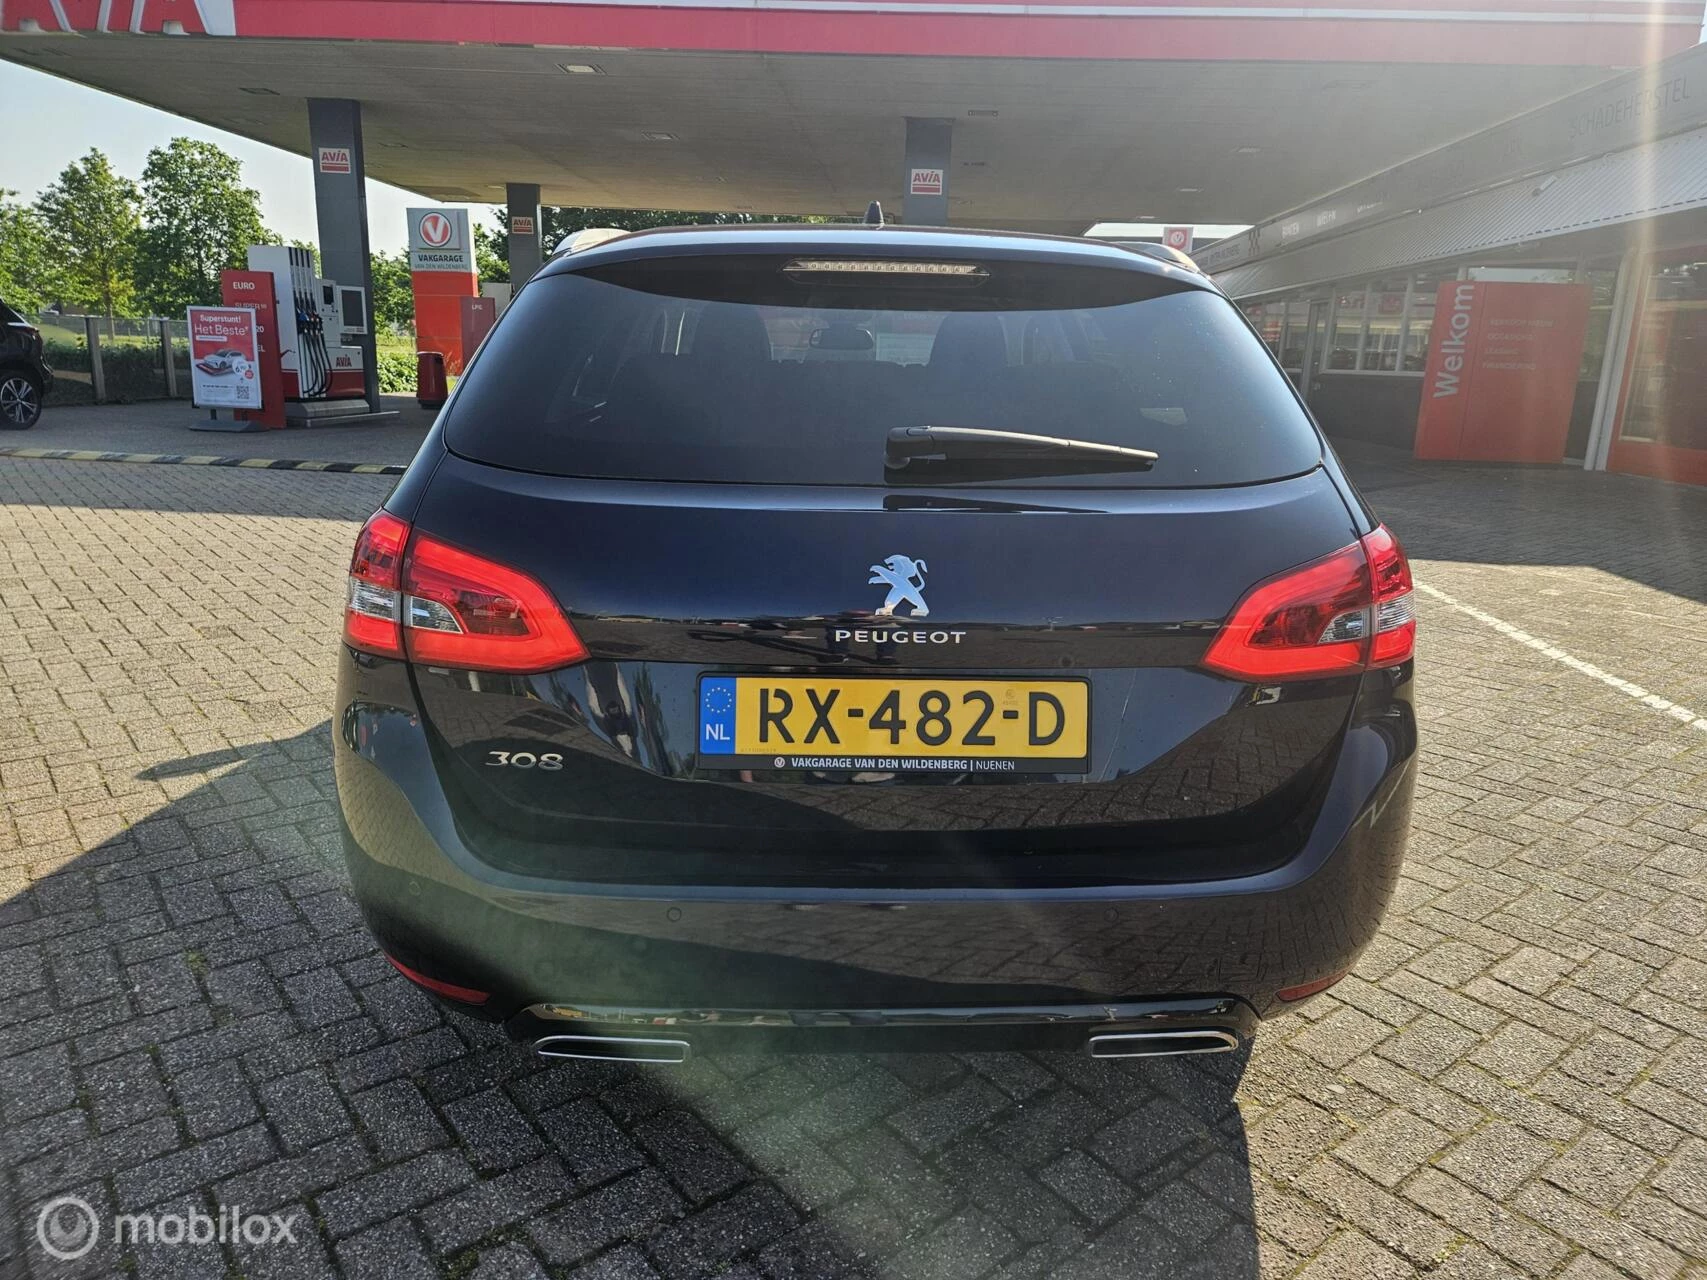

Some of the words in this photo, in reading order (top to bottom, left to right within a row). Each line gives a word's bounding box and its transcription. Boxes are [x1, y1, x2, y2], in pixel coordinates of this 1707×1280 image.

[321, 150, 349, 162] AVIA
[912, 171, 941, 183] AVIA
[417, 254, 464, 263] VAKGARAGE
[233, 281, 256, 290] EURO
[200, 314, 241, 323] Superstunt!
[194, 324, 213, 334] Het
[1433, 284, 1475, 398] Welkom
[336, 354, 352, 367] AVIA
[835, 630, 967, 644] PEUGEOT
[759, 688, 1065, 746] RX-482-D
[705, 723, 731, 741] NL
[485, 751, 564, 771] 308
[791, 757, 852, 768] VAKGARAGE
[854, 758, 875, 768] VAN
[878, 758, 899, 769] DEN
[901, 759, 967, 770] WILDENBERG
[975, 761, 1015, 770] NUENEN
